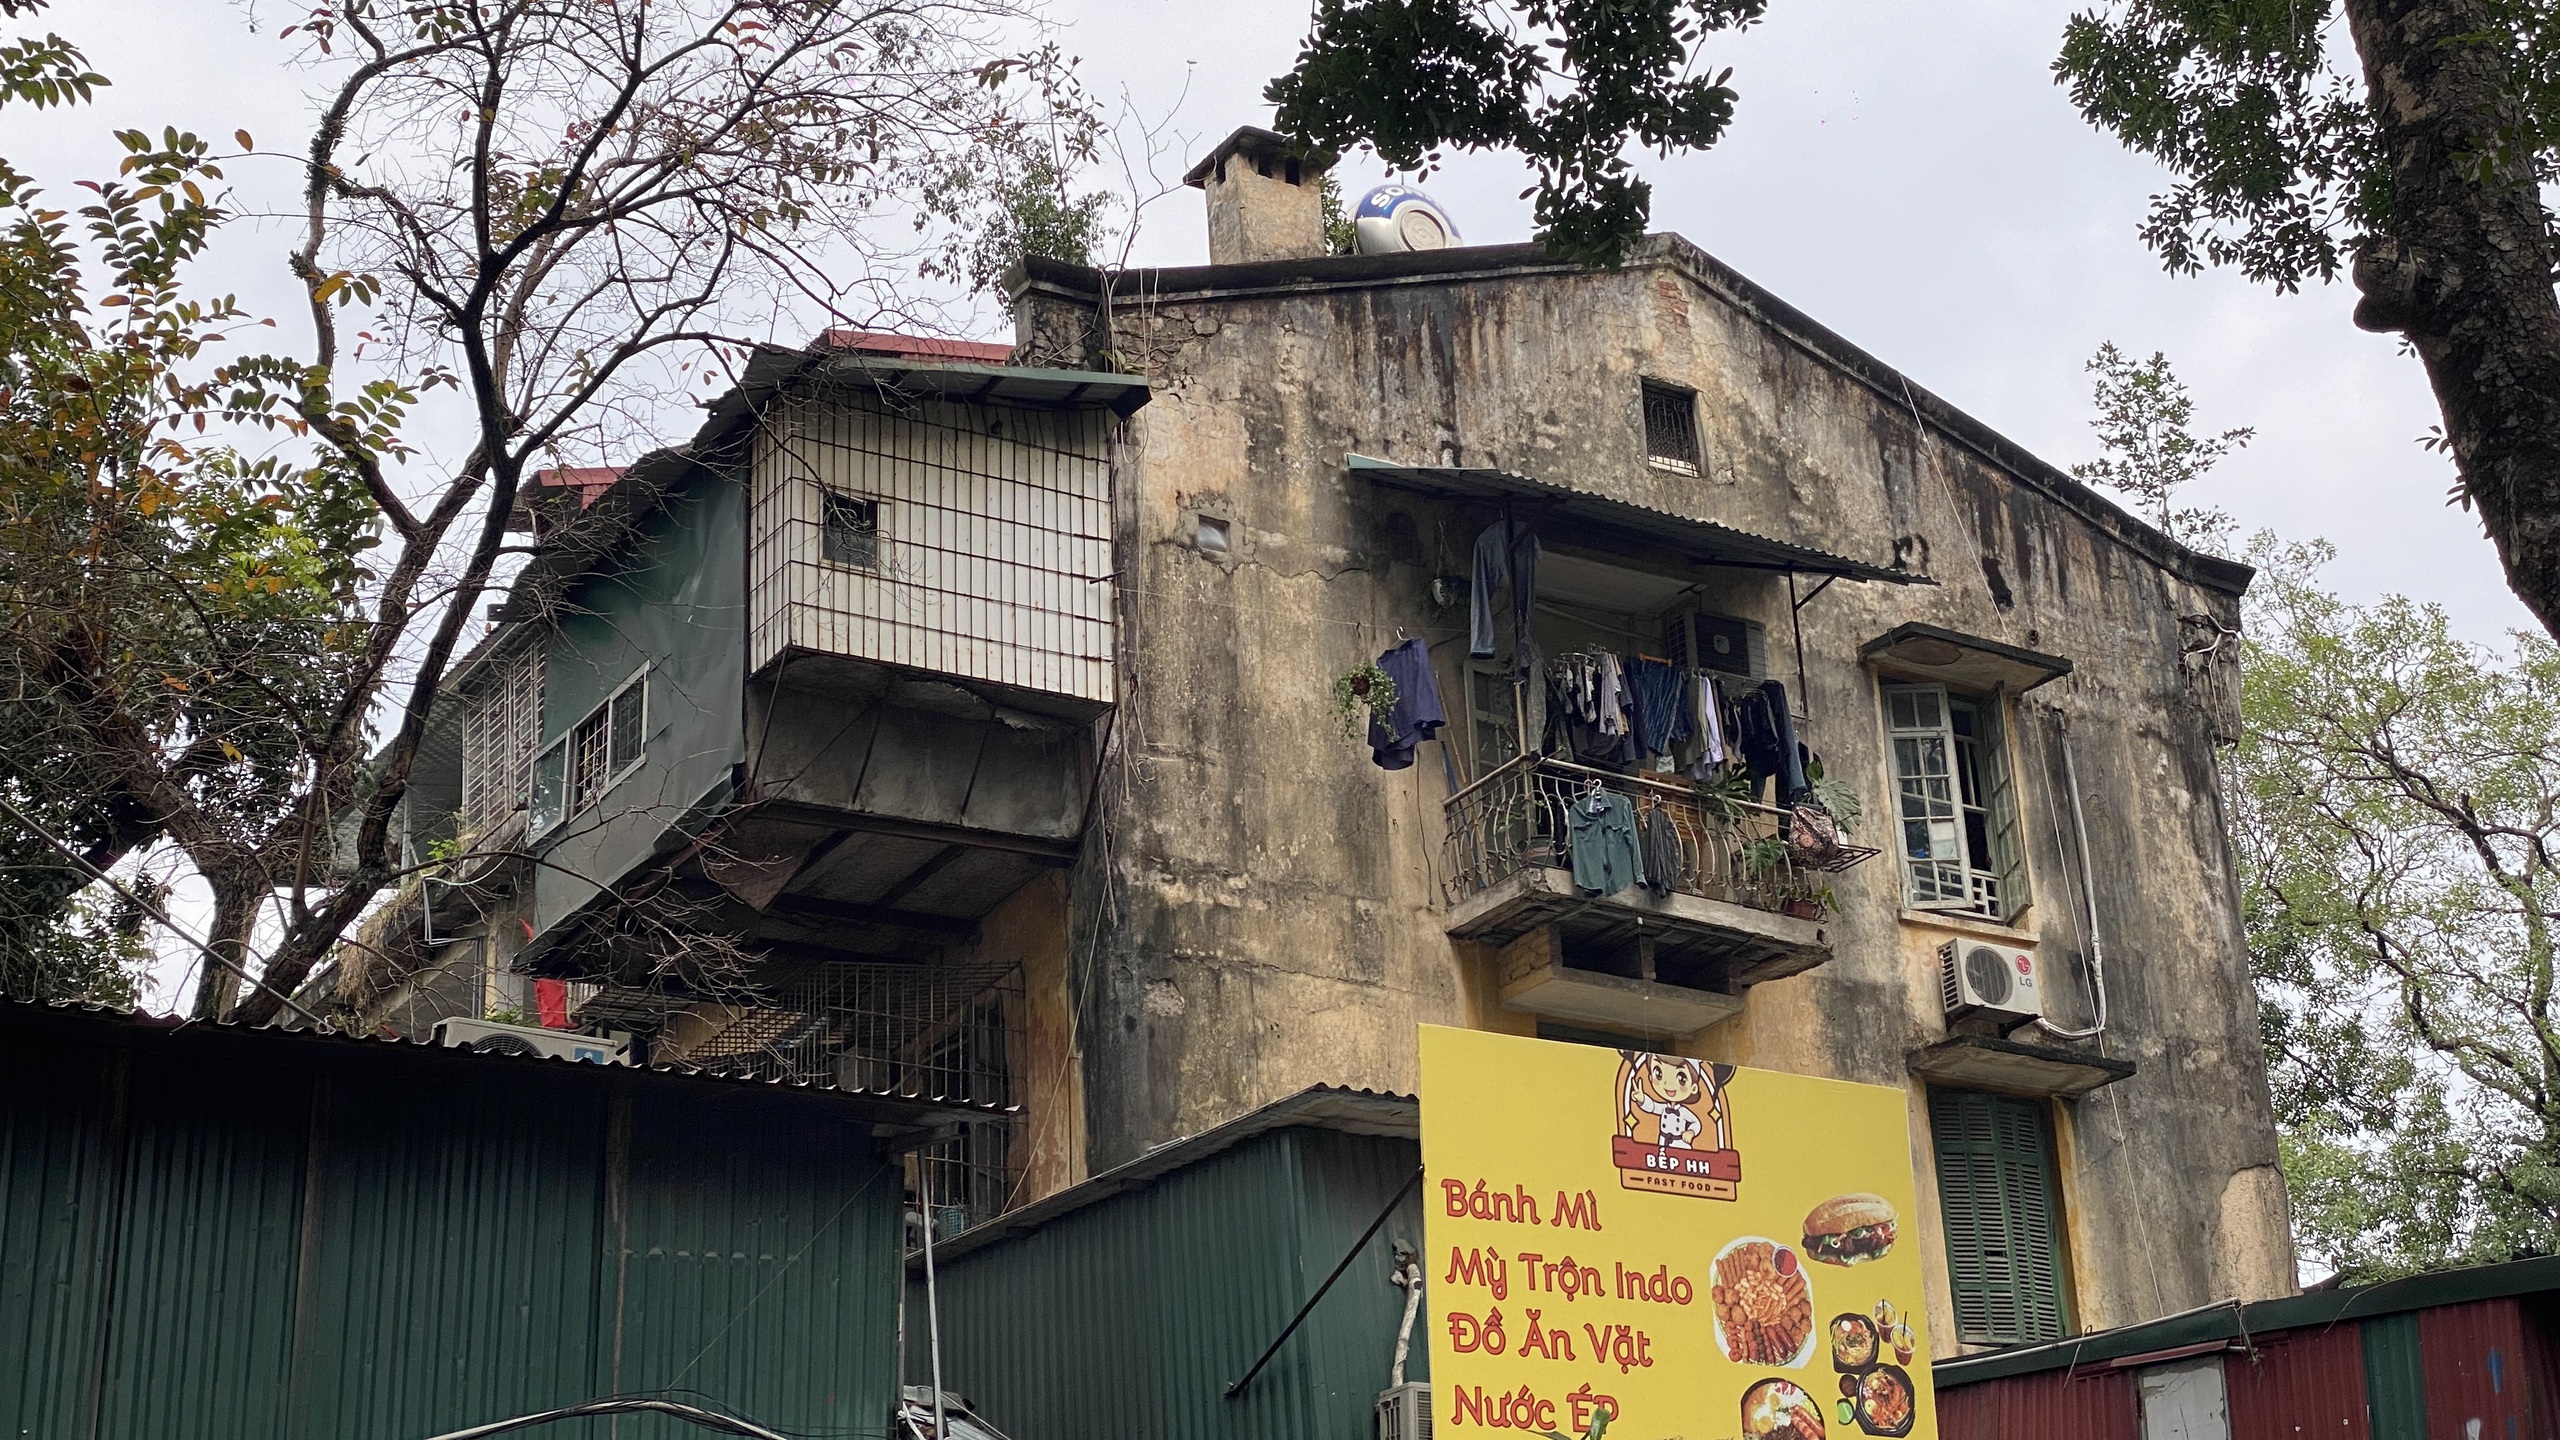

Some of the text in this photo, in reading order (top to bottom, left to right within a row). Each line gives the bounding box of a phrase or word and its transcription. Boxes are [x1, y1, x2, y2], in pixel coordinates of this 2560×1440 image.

[2019, 976, 2032, 987] LG
[1645, 1147, 1710, 1175] BẾP HH
[1647, 1176, 1711, 1192] FAST FOOD
[1441, 1178, 1602, 1231] Bánh Mì
[1445, 1246, 1693, 1305] Mỳ Trộn Indo
[1447, 1306, 1653, 1374] Đồ Ăn Vặt
[1451, 1382, 1619, 1434] Nước ÉP
